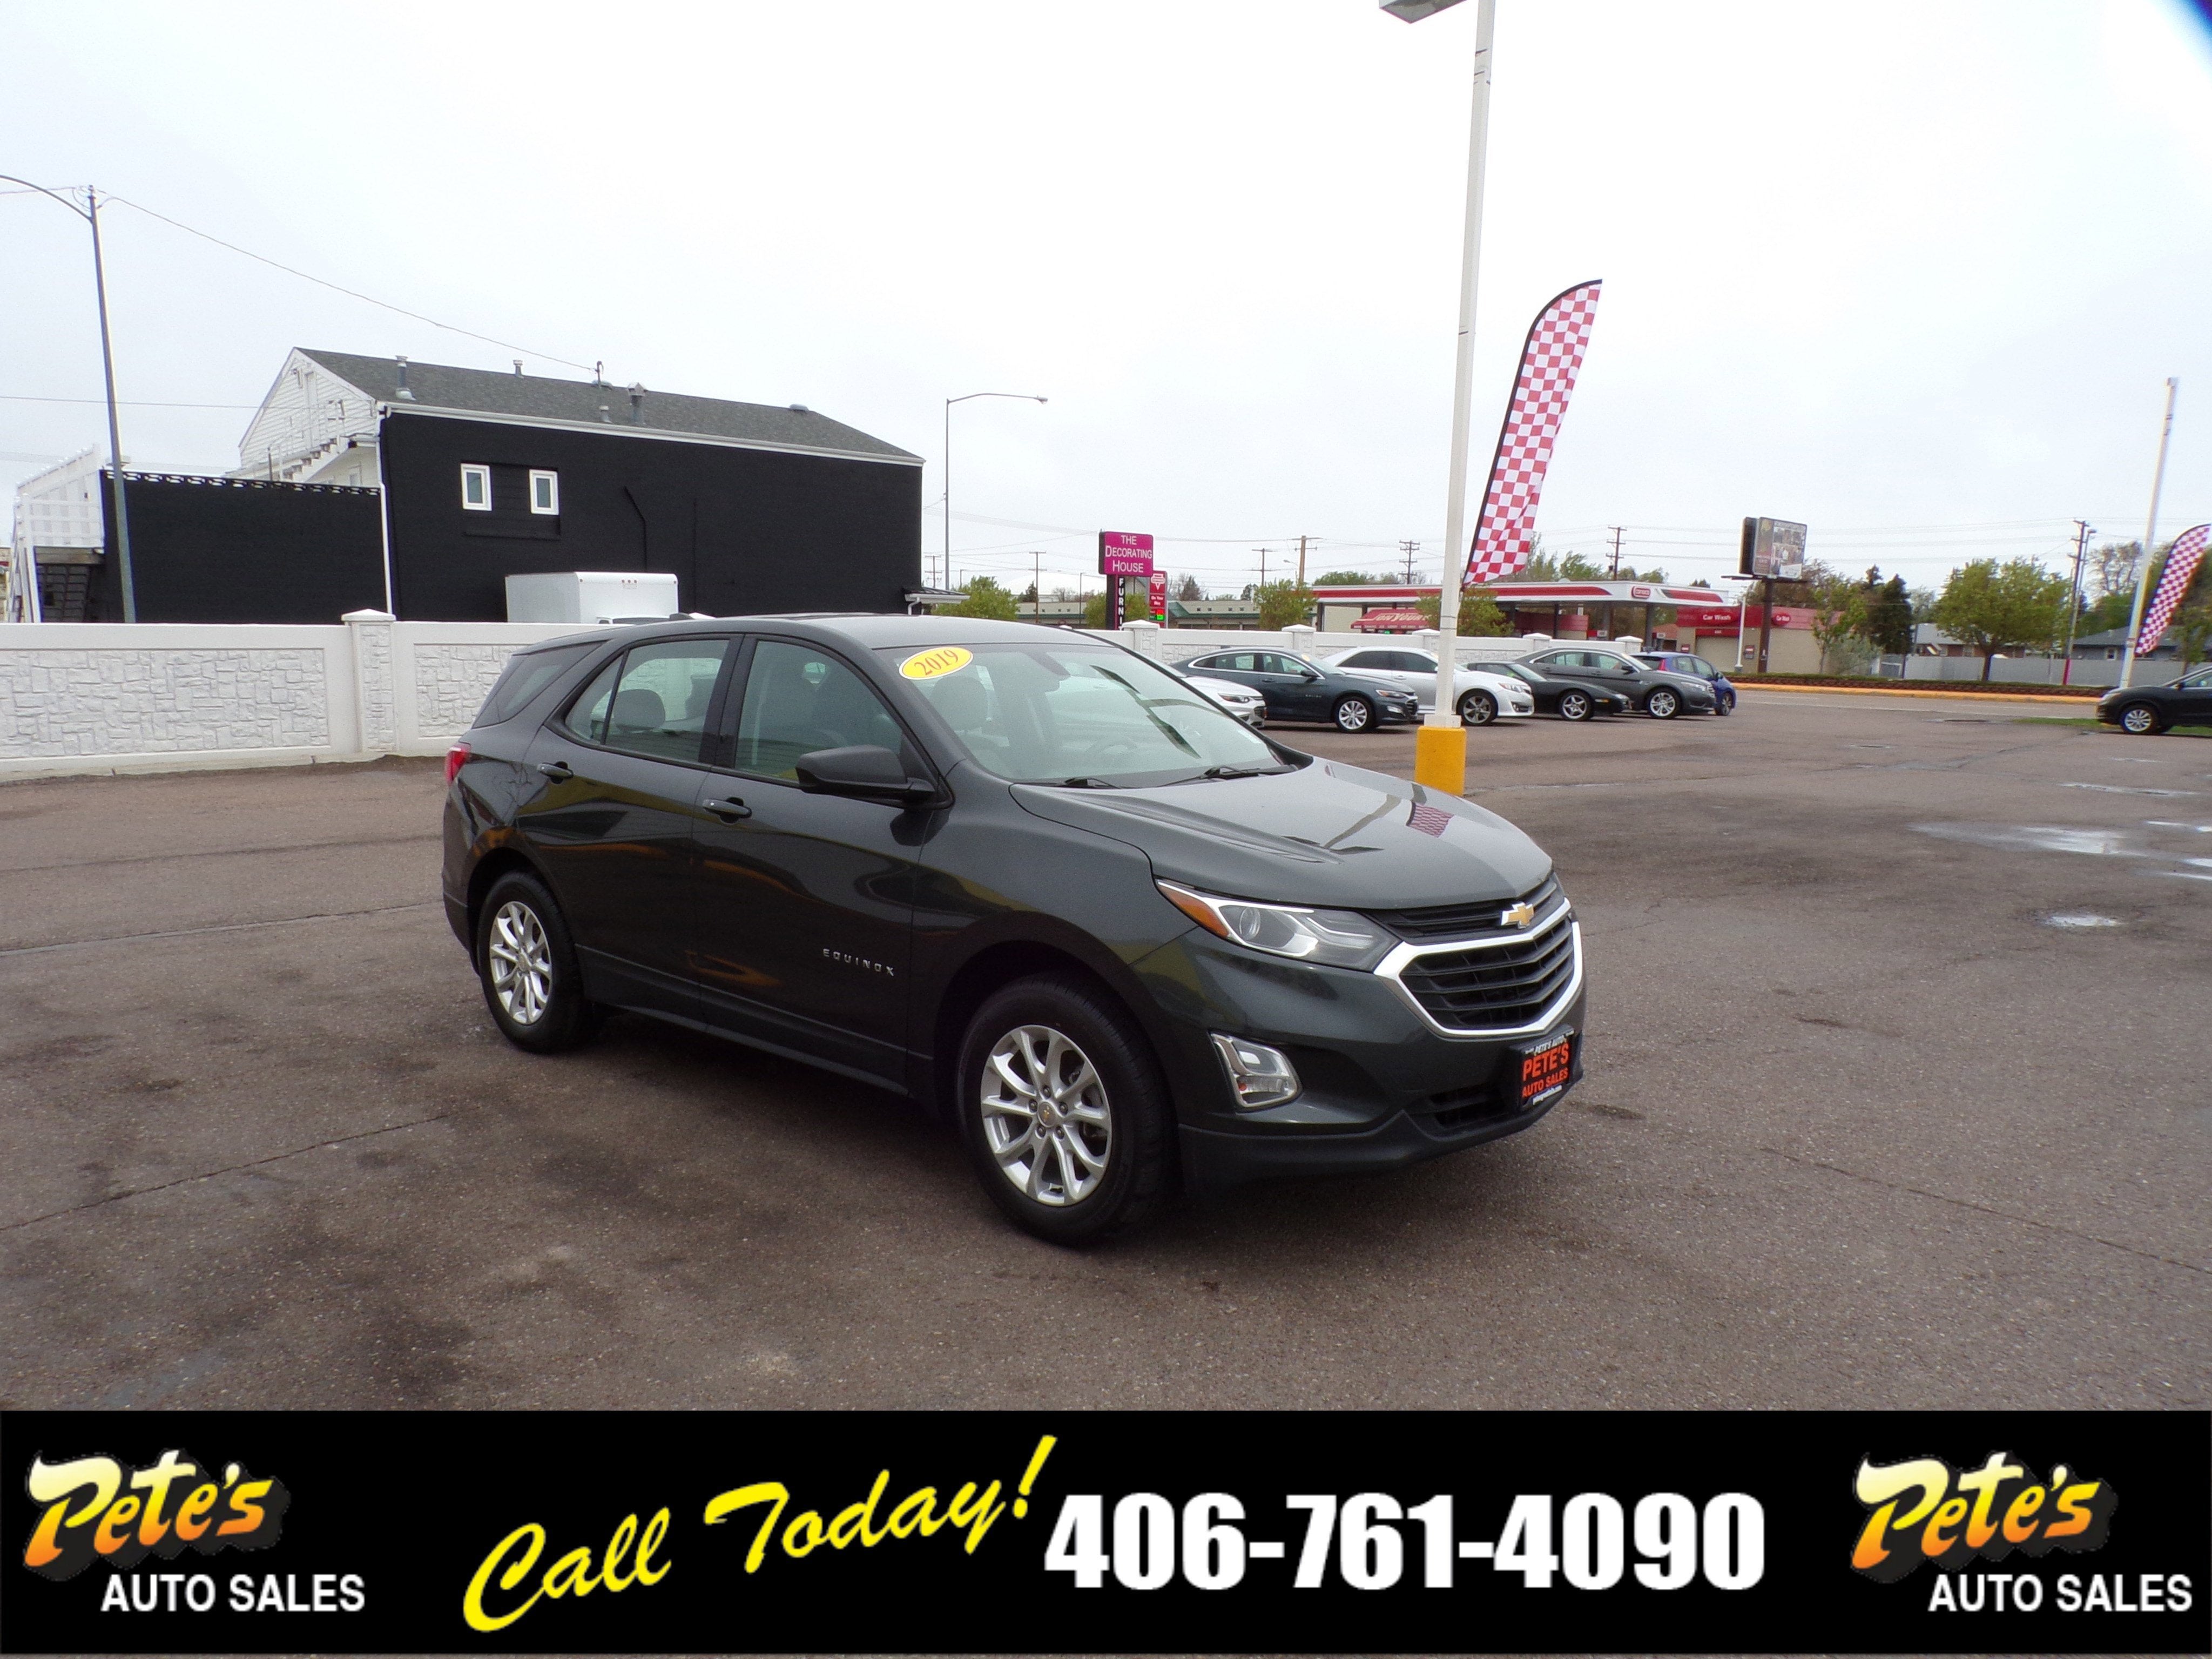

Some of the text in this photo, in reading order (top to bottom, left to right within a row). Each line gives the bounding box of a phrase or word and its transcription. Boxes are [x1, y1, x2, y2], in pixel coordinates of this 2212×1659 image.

[1105, 545, 1152, 559] DECORATING
[1121, 535, 1137, 545] THE
[1112, 560, 1144, 573] HOUSE
[914, 650, 959, 676] 2019
[823, 948, 894, 976] EQUINOX
[1523, 1043, 1569, 1081] PETE'S
[1522, 1079, 1544, 1098] AUTO
[1546, 1067, 1569, 1088] SALES
